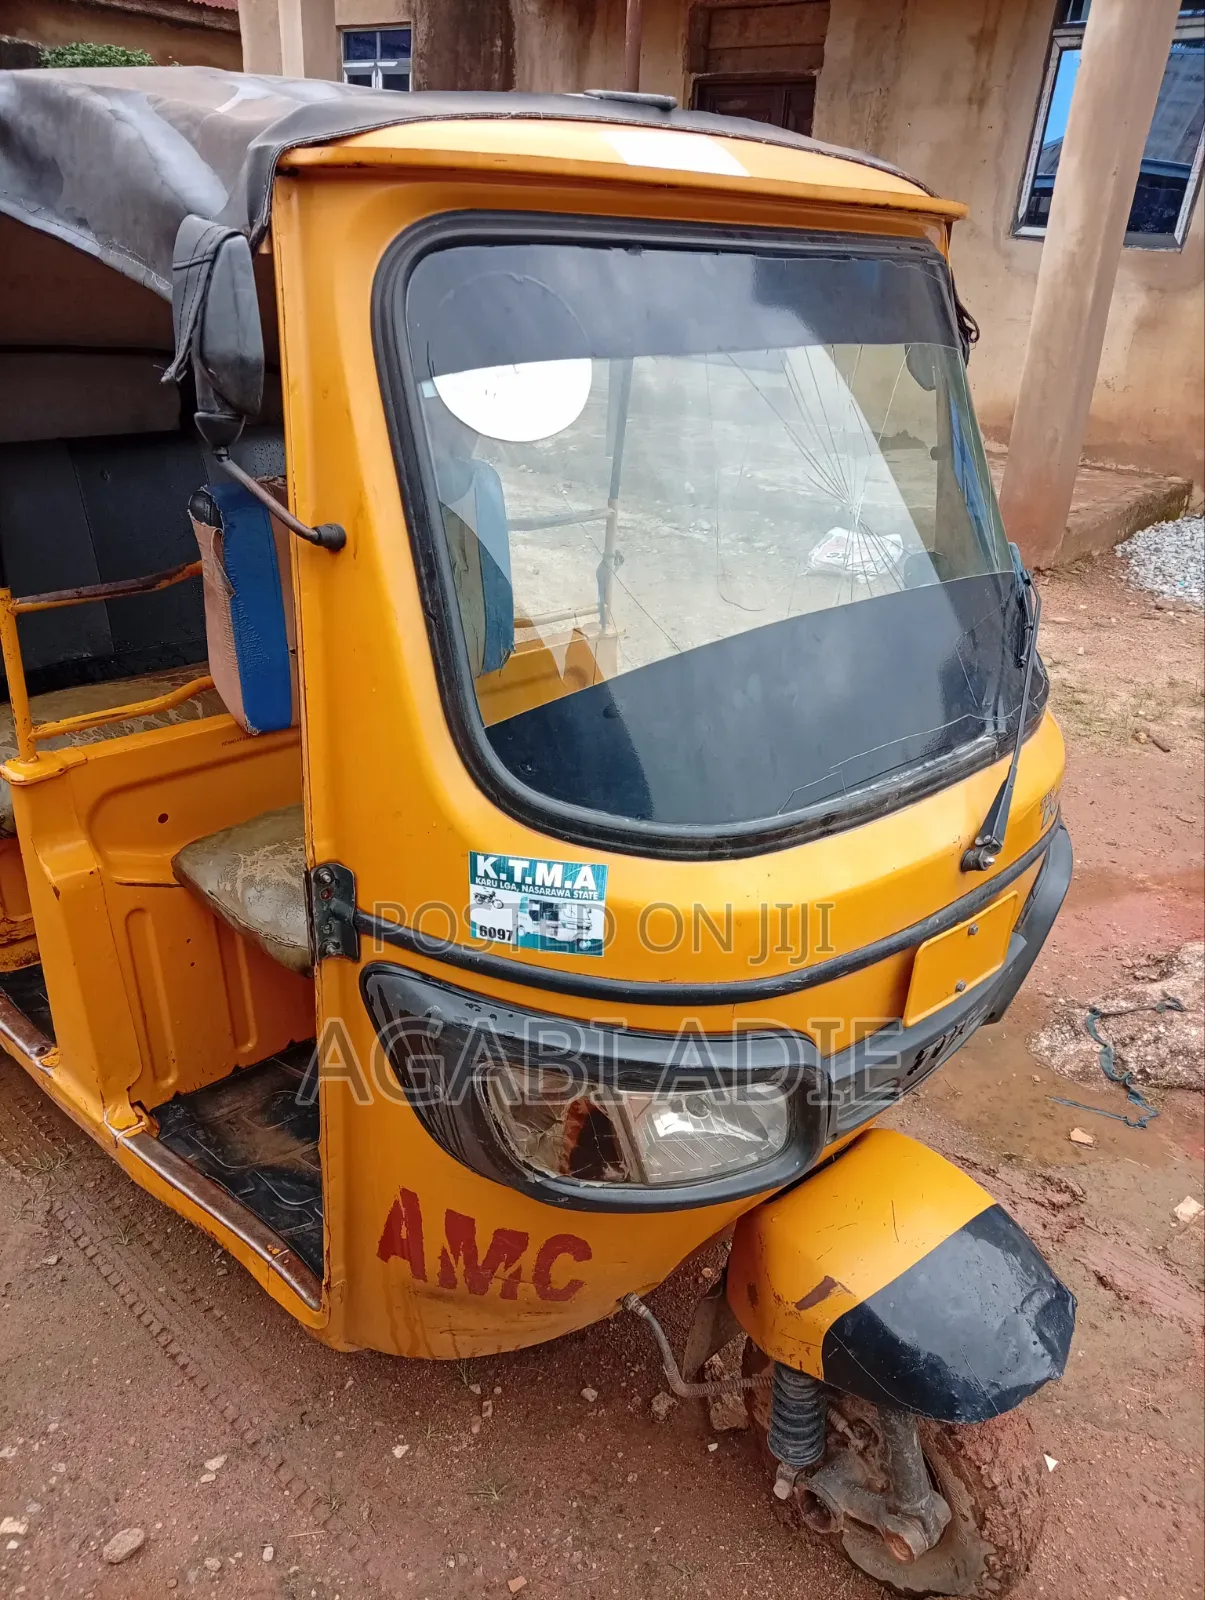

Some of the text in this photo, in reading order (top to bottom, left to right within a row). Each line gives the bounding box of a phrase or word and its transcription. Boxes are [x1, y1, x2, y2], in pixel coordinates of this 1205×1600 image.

[476, 855, 597, 891] K.T.M.A
[475, 877, 599, 900] KARU LGA, NASARAWA STATE
[479, 925, 513, 941] 6097
[376, 1185, 592, 1302] AMC
